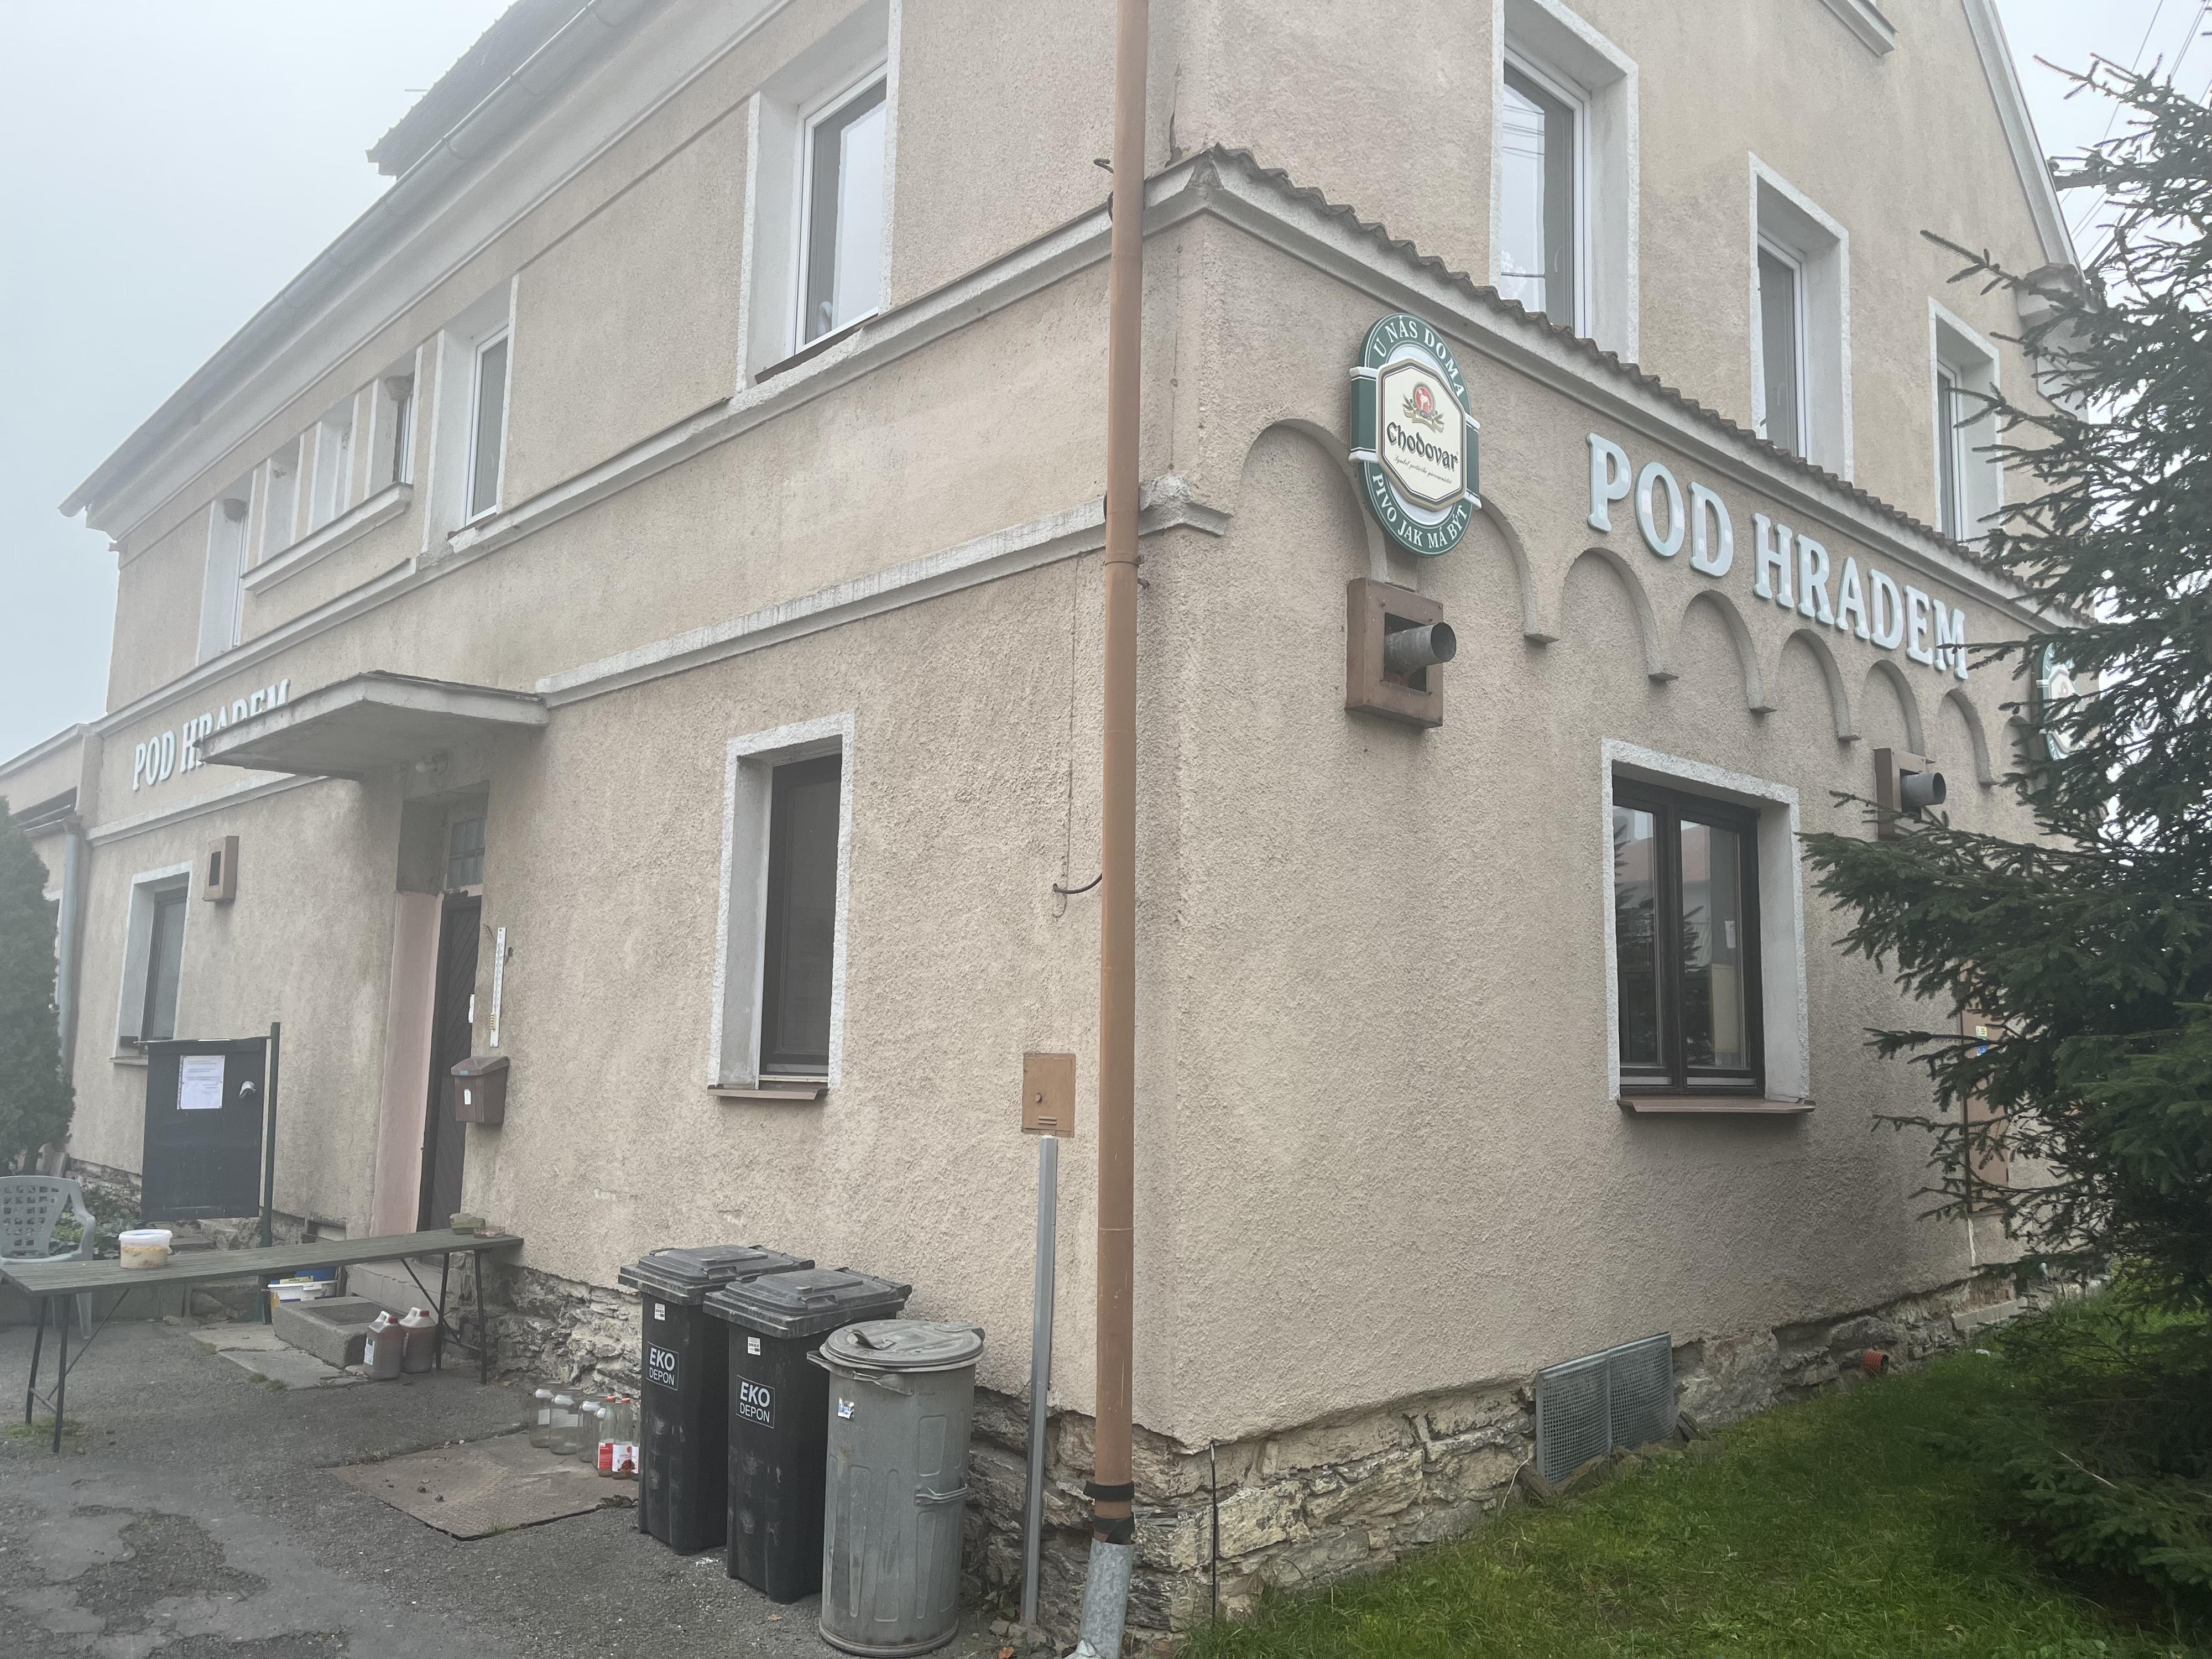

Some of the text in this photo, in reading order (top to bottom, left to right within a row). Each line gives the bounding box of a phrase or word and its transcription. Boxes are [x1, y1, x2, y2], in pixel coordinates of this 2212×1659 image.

[1373, 315, 1465, 397] U NÁS DOMA
[1387, 422, 1459, 472] Chodovar
[1372, 473, 1467, 548] PIVO JAK MÁ BÝT
[1587, 432, 1969, 680] POD HRADEM
[133, 730, 176, 791] POD
[649, 1367, 675, 1385] DEPON
[650, 1347, 675, 1371] EKO
[740, 1381, 770, 1407] EKO
[740, 1402, 770, 1423] DEPON
